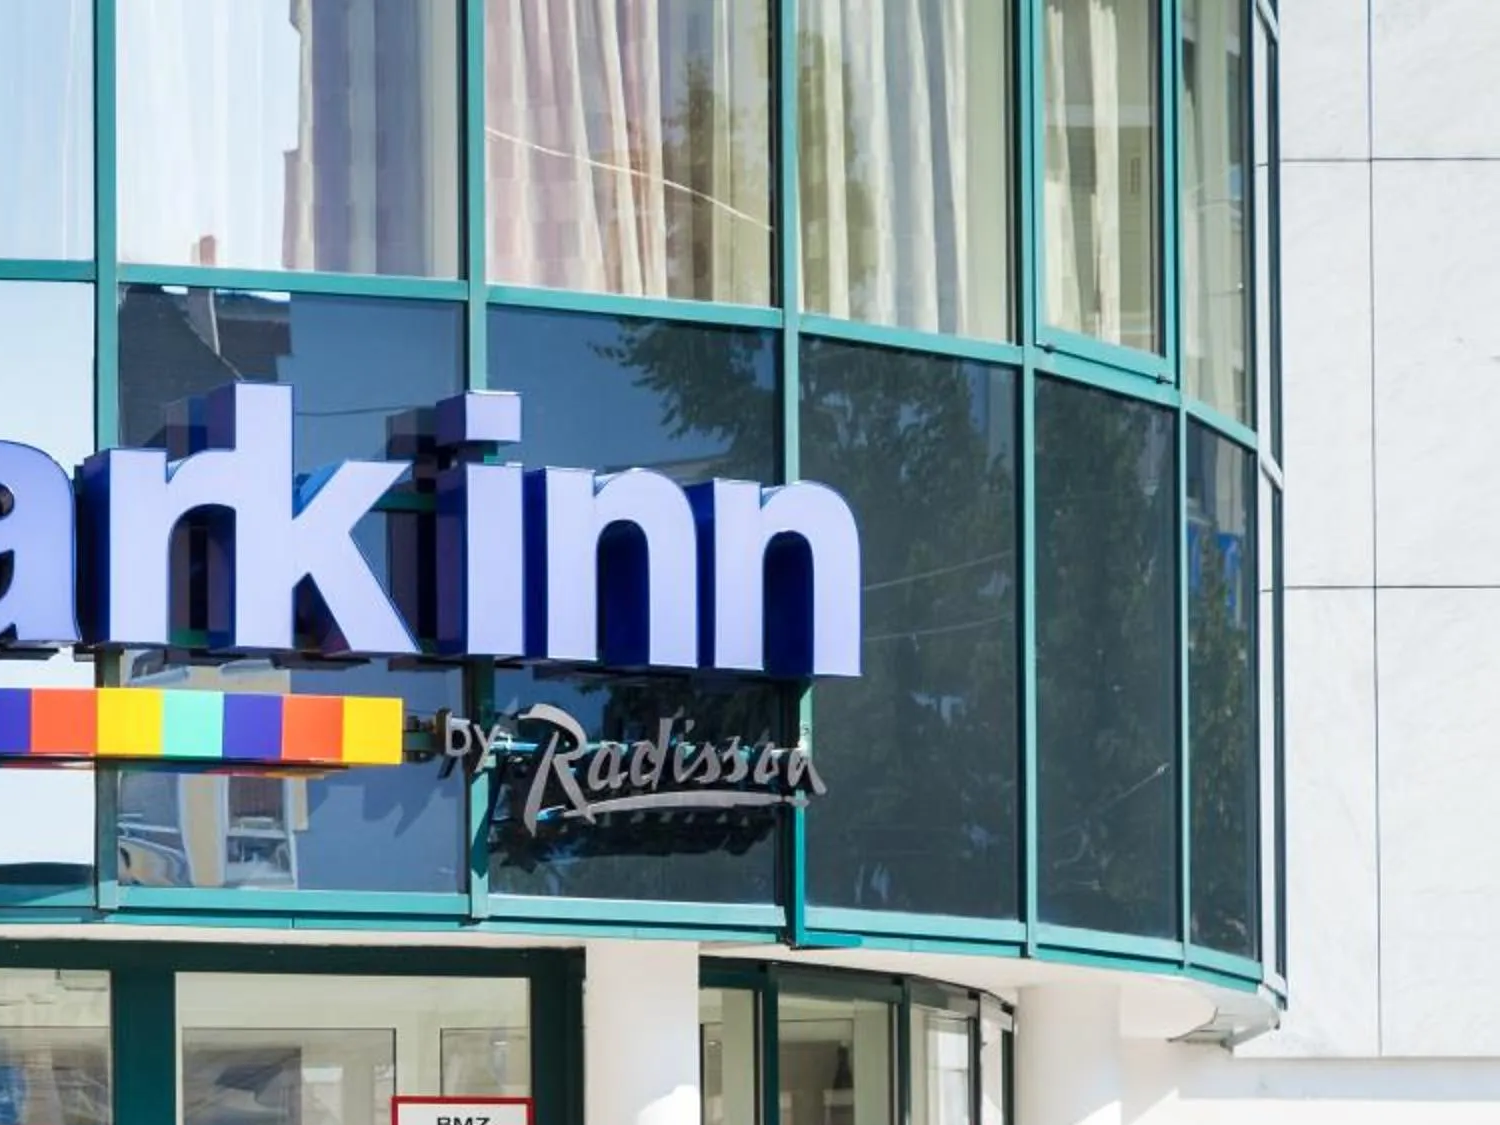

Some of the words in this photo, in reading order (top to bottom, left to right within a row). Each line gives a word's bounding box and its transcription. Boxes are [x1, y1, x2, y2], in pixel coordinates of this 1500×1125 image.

[460, 390, 863, 678] inn
[444, 712, 499, 773] by
[523, 703, 829, 838] Radisson
